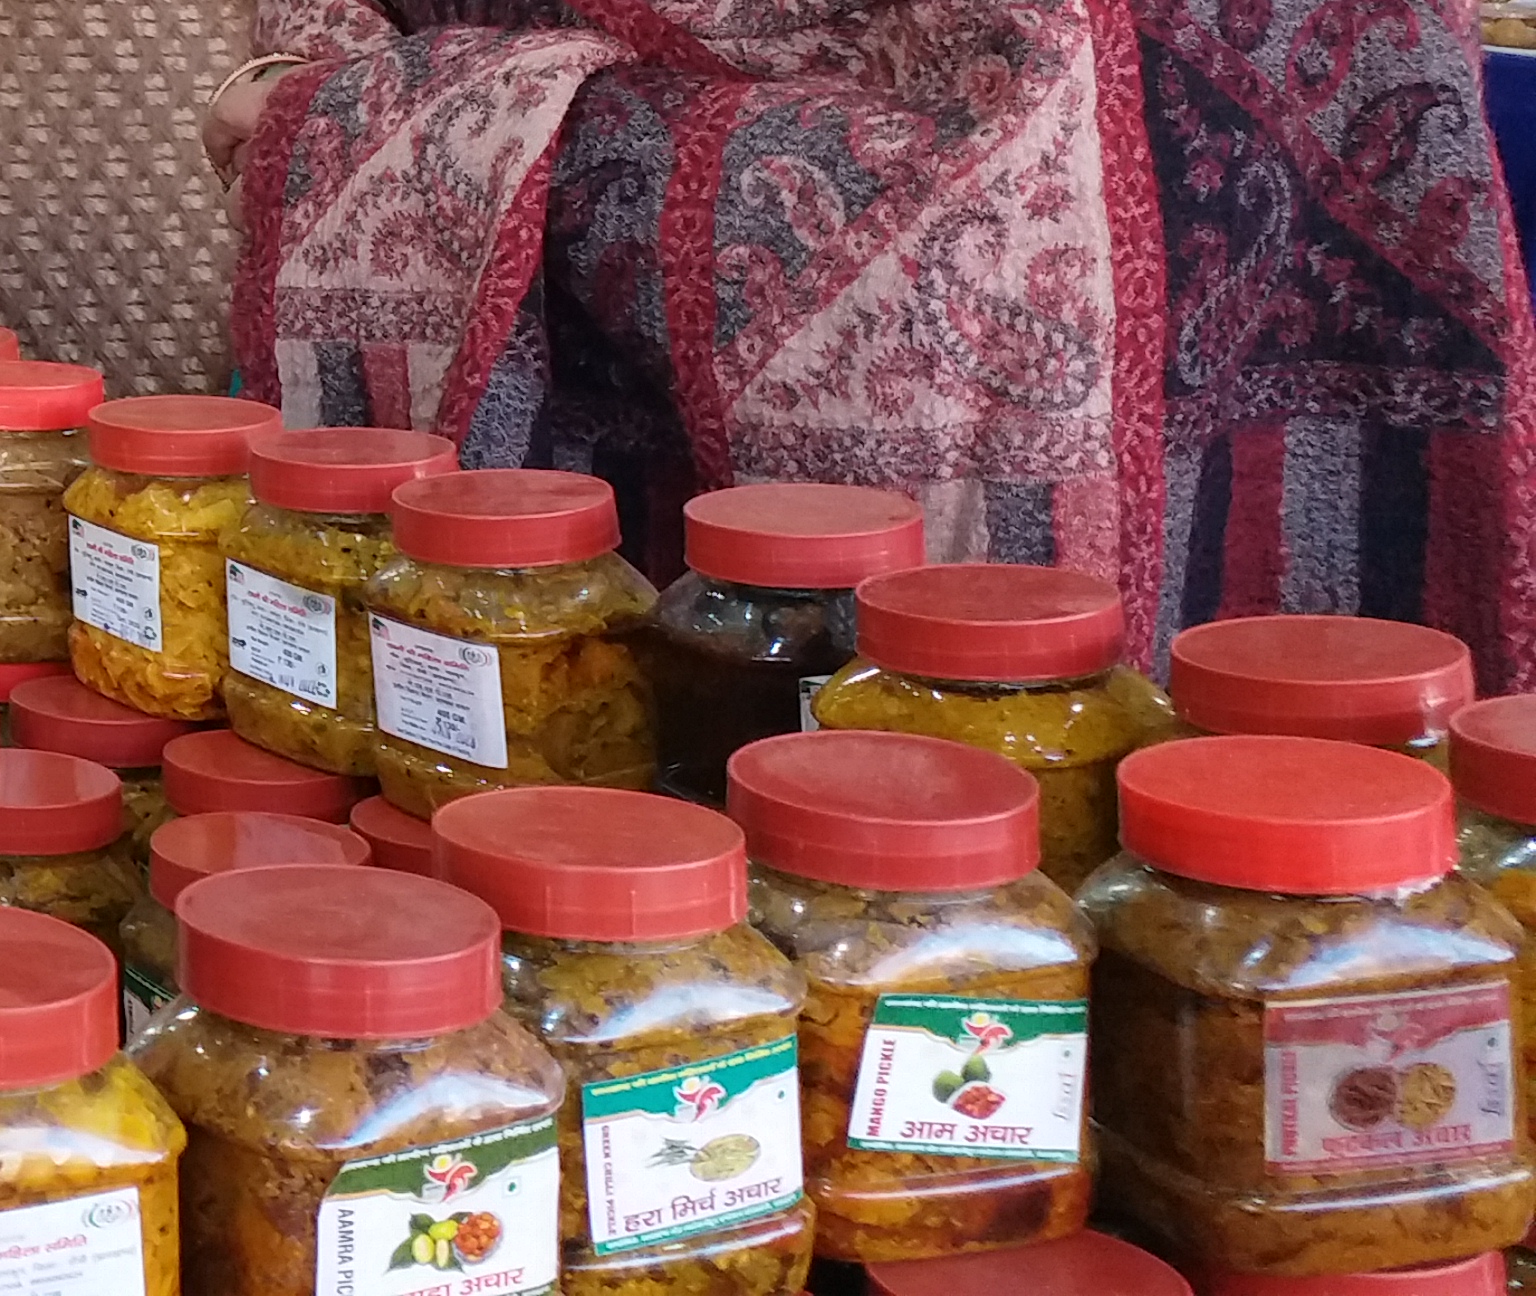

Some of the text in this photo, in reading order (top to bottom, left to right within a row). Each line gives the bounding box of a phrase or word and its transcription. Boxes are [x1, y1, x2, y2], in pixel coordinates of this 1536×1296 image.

[866, 1038, 897, 1137] MANGO PICKLE
[899, 1119, 1034, 1145] आम अचार
[623, 1177, 783, 1233] हरा मिर्च अचार
[337, 1208, 355, 1265] AAMRA
[459, 1266, 526, 1296] अचार
